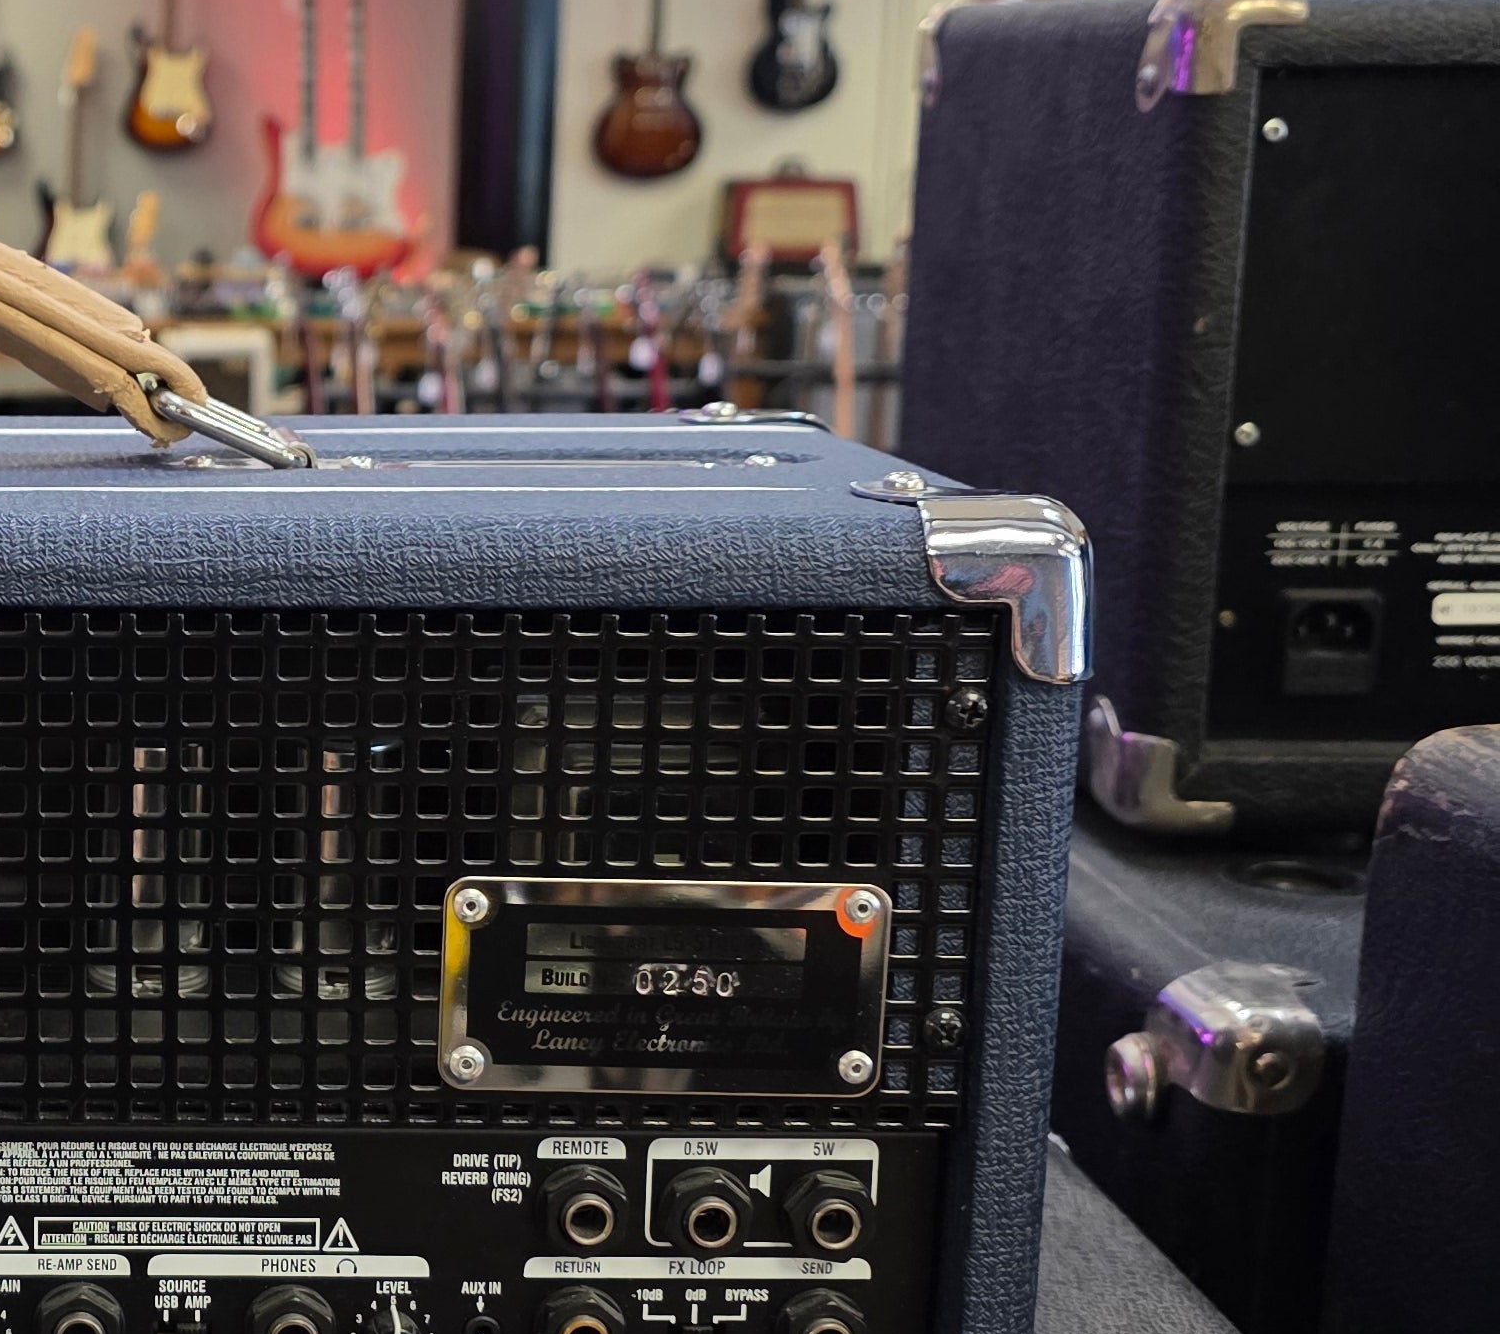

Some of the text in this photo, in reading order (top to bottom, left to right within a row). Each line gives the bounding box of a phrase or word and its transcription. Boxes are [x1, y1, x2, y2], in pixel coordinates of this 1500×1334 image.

[531, 1028, 604, 1057] Laney
[552, 1141, 609, 1155] REMOTE
[684, 1141, 719, 1156] 0.5W
[812, 1142, 835, 1157] 5W
[453, 1153, 522, 1170] DRIVE (TIP)
[441, 1171, 531, 1188] REVERB (RING)
[491, 1188, 523, 1205] (FS2)
[72, 1222, 281, 1233] CAUTION RISK OF ELECTRIC SHOCK DO NOT OPEN
[41, 1234, 86, 1244] ATTENTION
[94, 1234, 126, 1244] RISQUE
[127, 1234, 139, 1244] DE
[243, 1234, 255, 1244] NE
[295, 1235, 312, 1245] PAS
[37, 1259, 117, 1271] RE-AMP SEND
[261, 1259, 316, 1273] PHONES
[554, 1261, 601, 1274] RETURN
[669, 1261, 726, 1275] FX LOOP
[801, 1262, 833, 1275] SEND
[159, 1279, 206, 1293] SOURCE
[376, 1281, 411, 1294] LEVEL
[461, 1282, 501, 1295] AUX IN
[631, 1288, 663, 1301] -10dB
[685, 1288, 706, 1301] 0dB
[725, 1288, 769, 1302] BYPASS
[154, 1295, 178, 1308] USB
[184, 1295, 211, 1308] AMP
